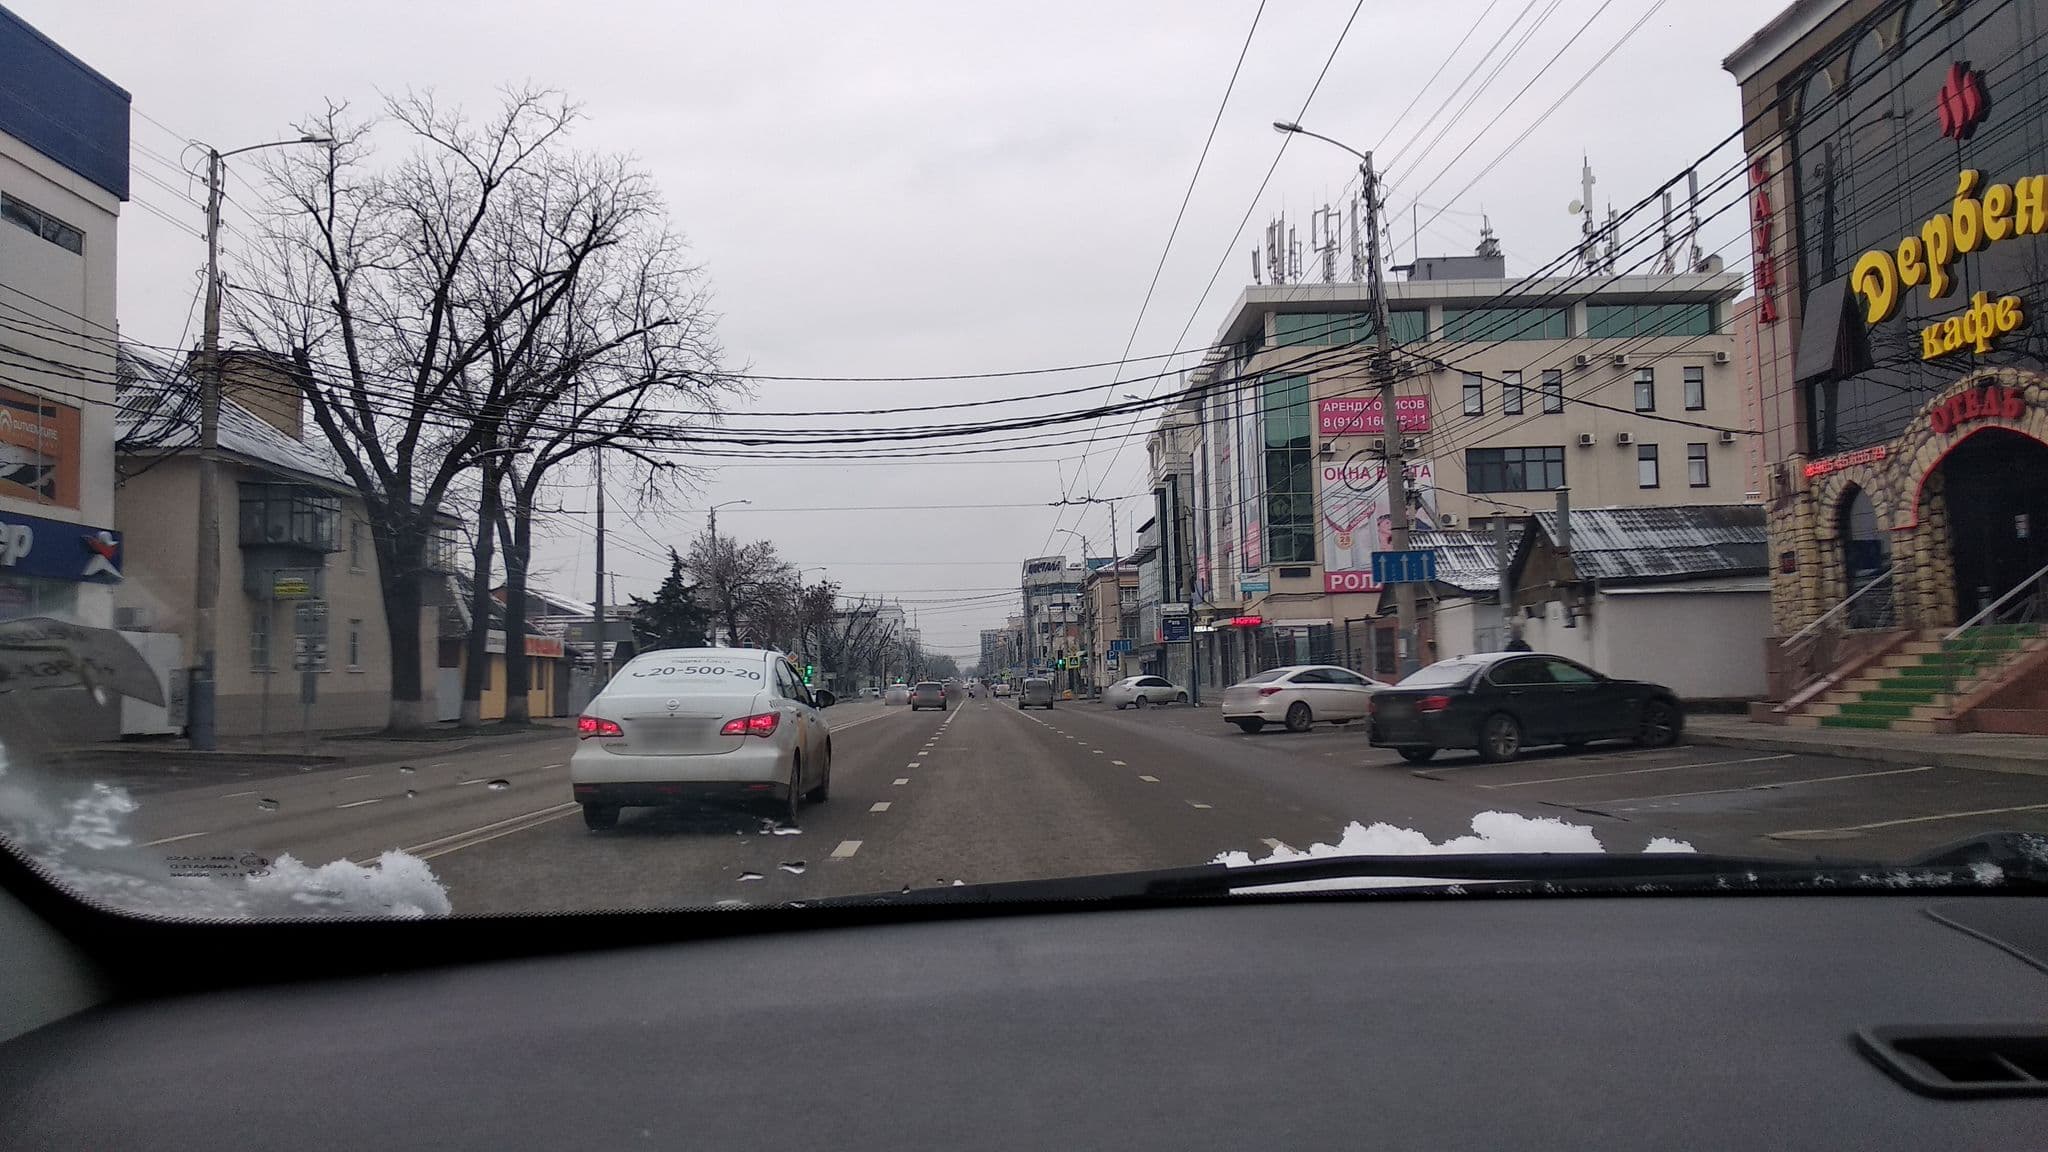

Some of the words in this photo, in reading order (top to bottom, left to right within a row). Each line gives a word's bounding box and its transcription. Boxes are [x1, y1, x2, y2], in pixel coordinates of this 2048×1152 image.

[1751, 155, 1778, 324] САУНА
[1921, 290, 2023, 361] кафе
[1323, 401, 1371, 413] АРЕНДА
[1930, 386, 2026, 434] ОТЕЛЬ
[1323, 418, 1331, 428] 8
[1324, 466, 1371, 481] ОКНА
[648, 666, 761, 680] 20-500-20
